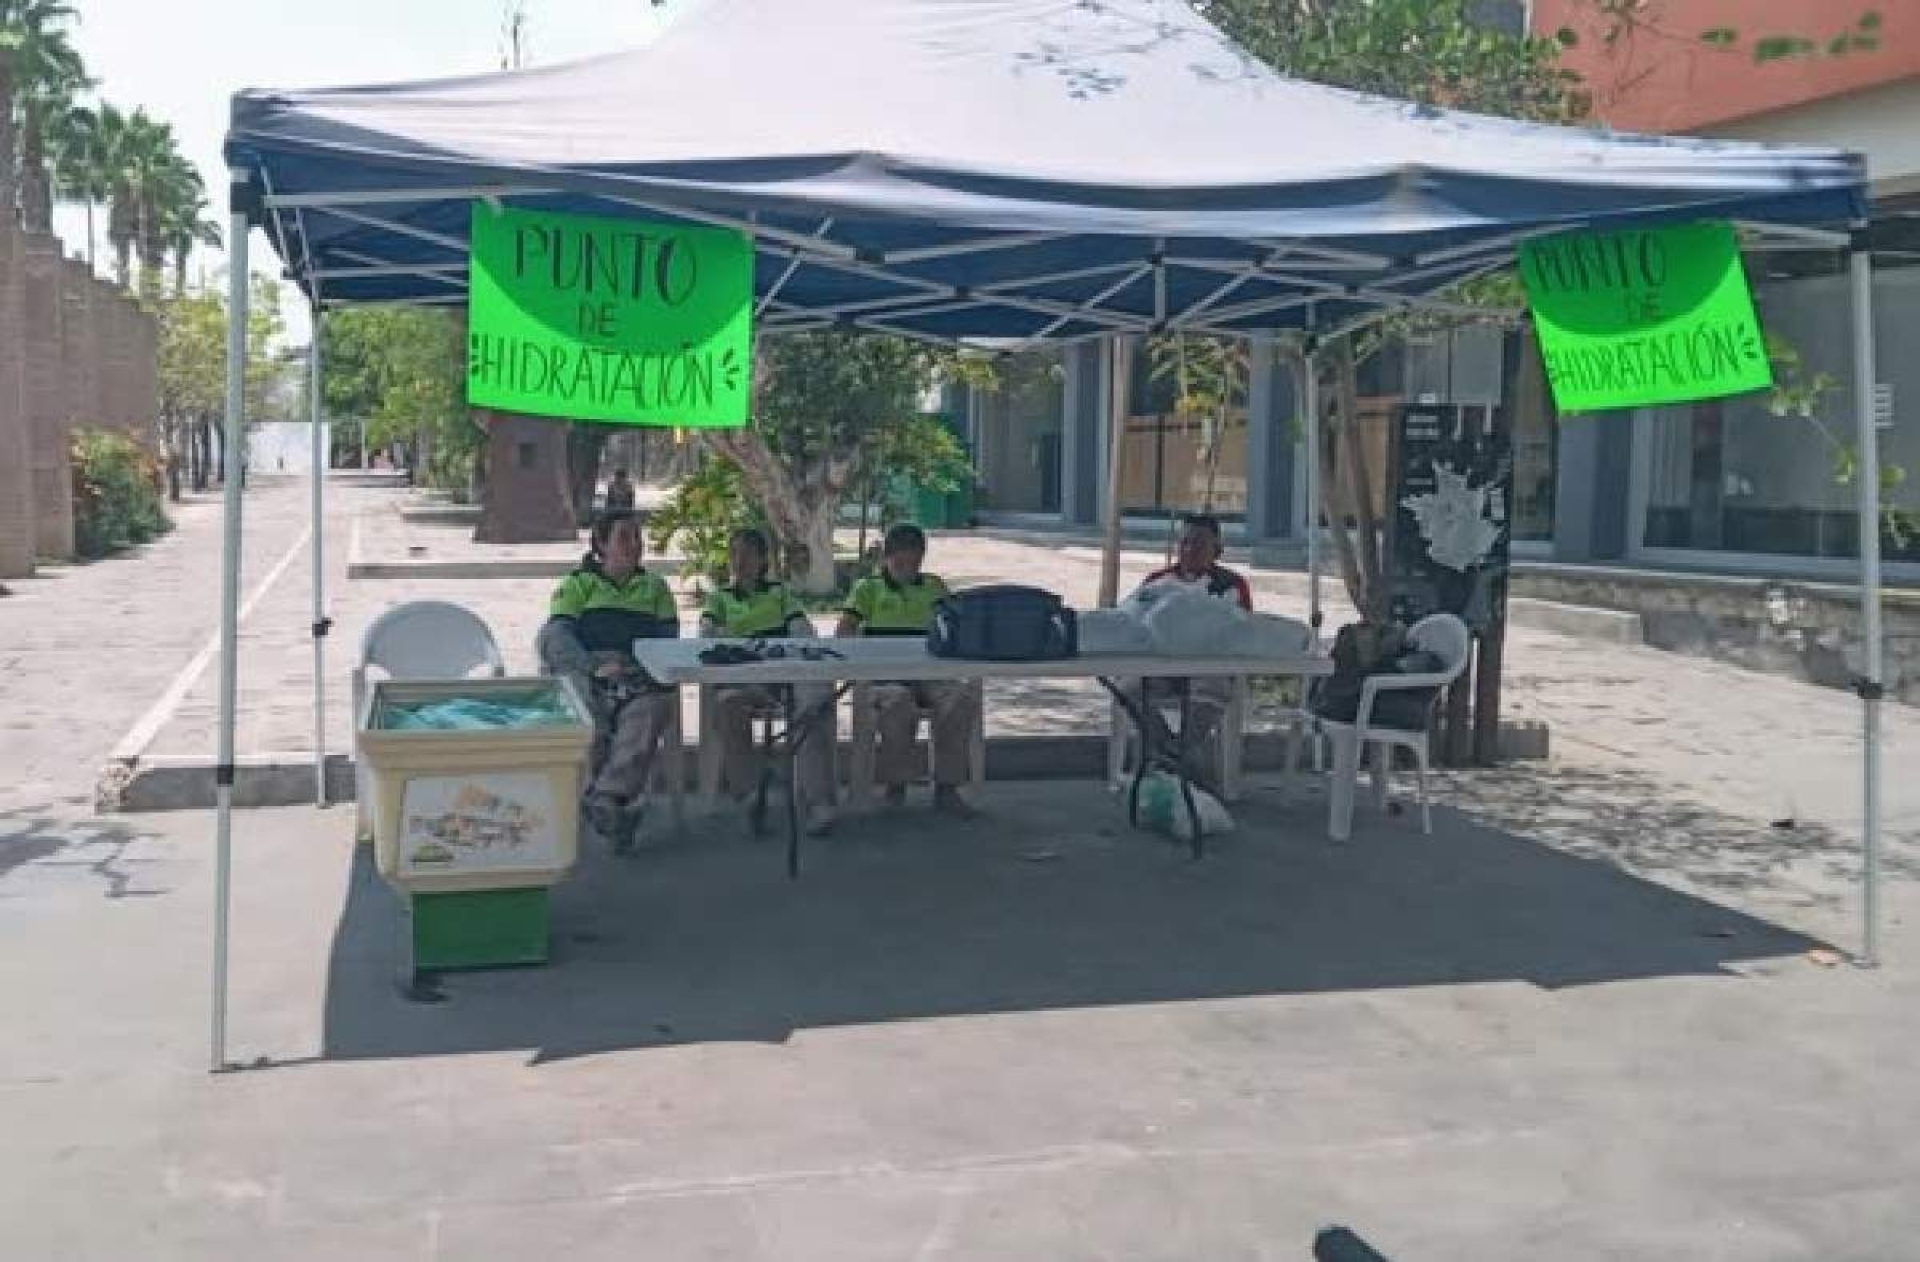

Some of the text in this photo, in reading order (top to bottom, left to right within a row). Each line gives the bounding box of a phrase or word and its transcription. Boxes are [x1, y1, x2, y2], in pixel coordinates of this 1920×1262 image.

[513, 223, 697, 306] PUNTO
[1534, 231, 1666, 292] PUNTO
[577, 301, 617, 336] DE
[1625, 292, 1661, 324] DE
[480, 332, 714, 410] HIDRATACIÓN
